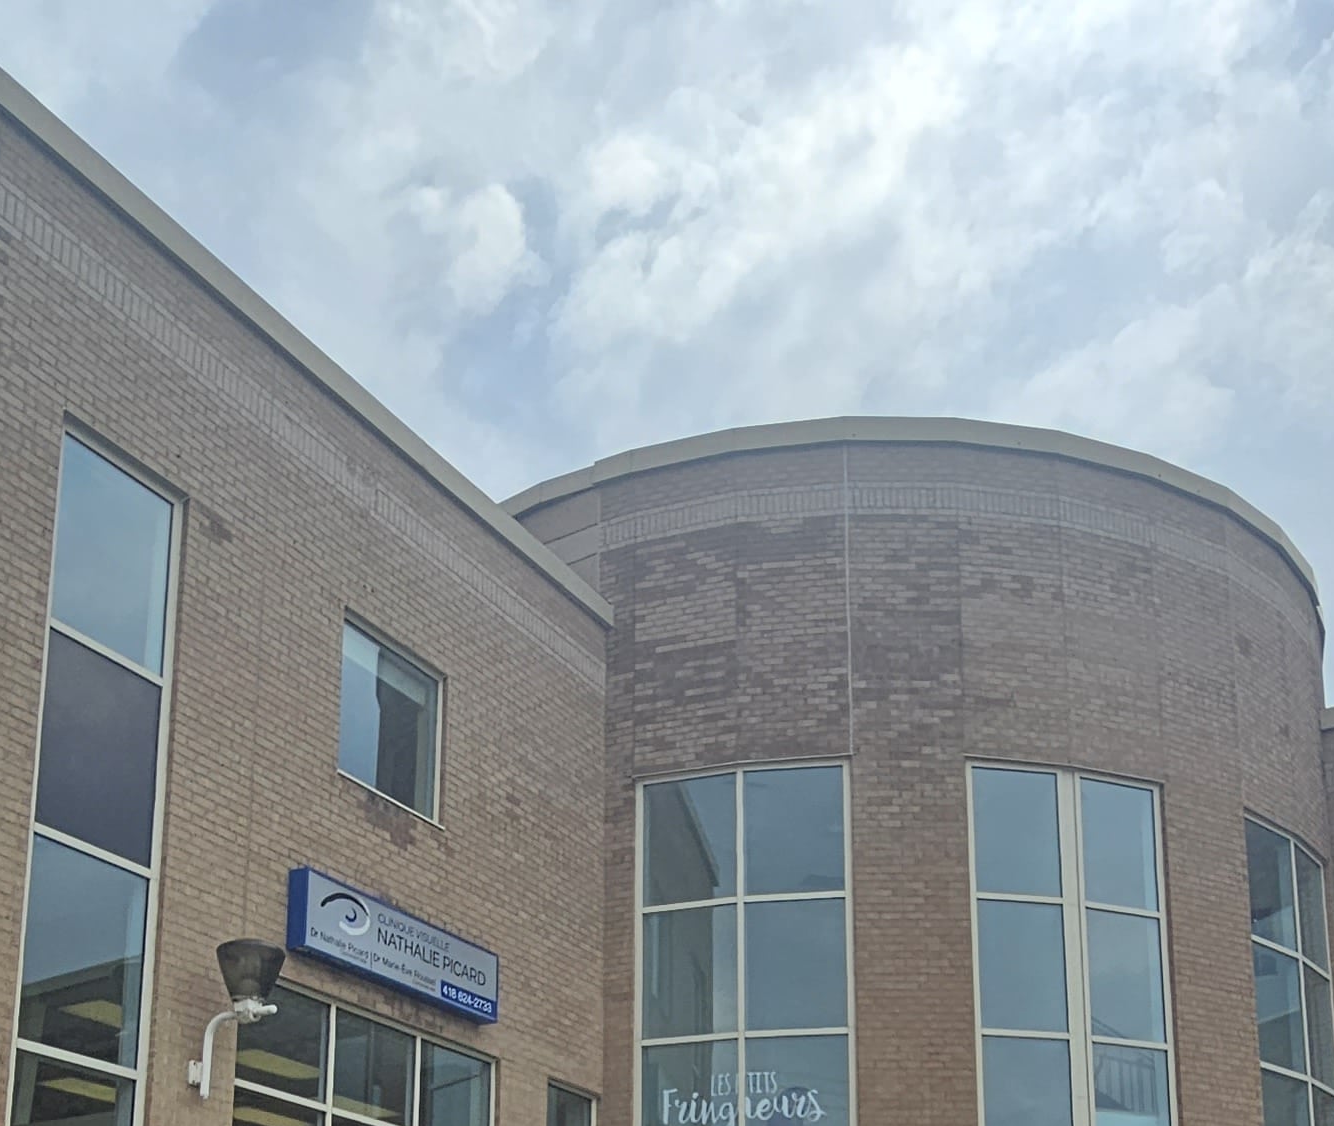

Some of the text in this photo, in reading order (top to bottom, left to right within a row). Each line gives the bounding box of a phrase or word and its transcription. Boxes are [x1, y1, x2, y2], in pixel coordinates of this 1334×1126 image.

[377, 913, 451, 951] CLINIQUE VISUELLE
[377, 928, 486, 986] NATHALIE PICARD
[442, 984, 457, 1000] 418
[710, 1071, 779, 1097] LES TITS
